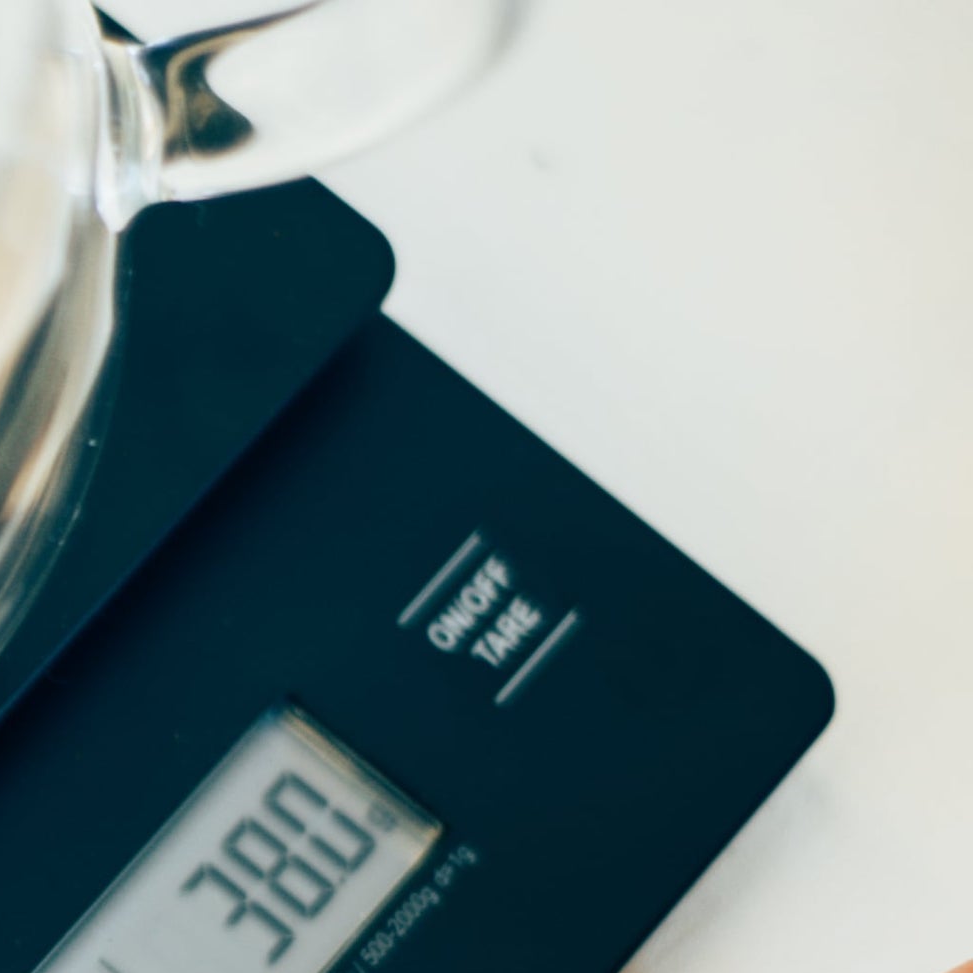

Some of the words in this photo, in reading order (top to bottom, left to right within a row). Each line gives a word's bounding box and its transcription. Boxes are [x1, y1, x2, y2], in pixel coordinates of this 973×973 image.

[428, 554, 509, 651] ON/OFF
[471, 596, 541, 667] TARE
[361, 886, 440, 965] 500-2000g
